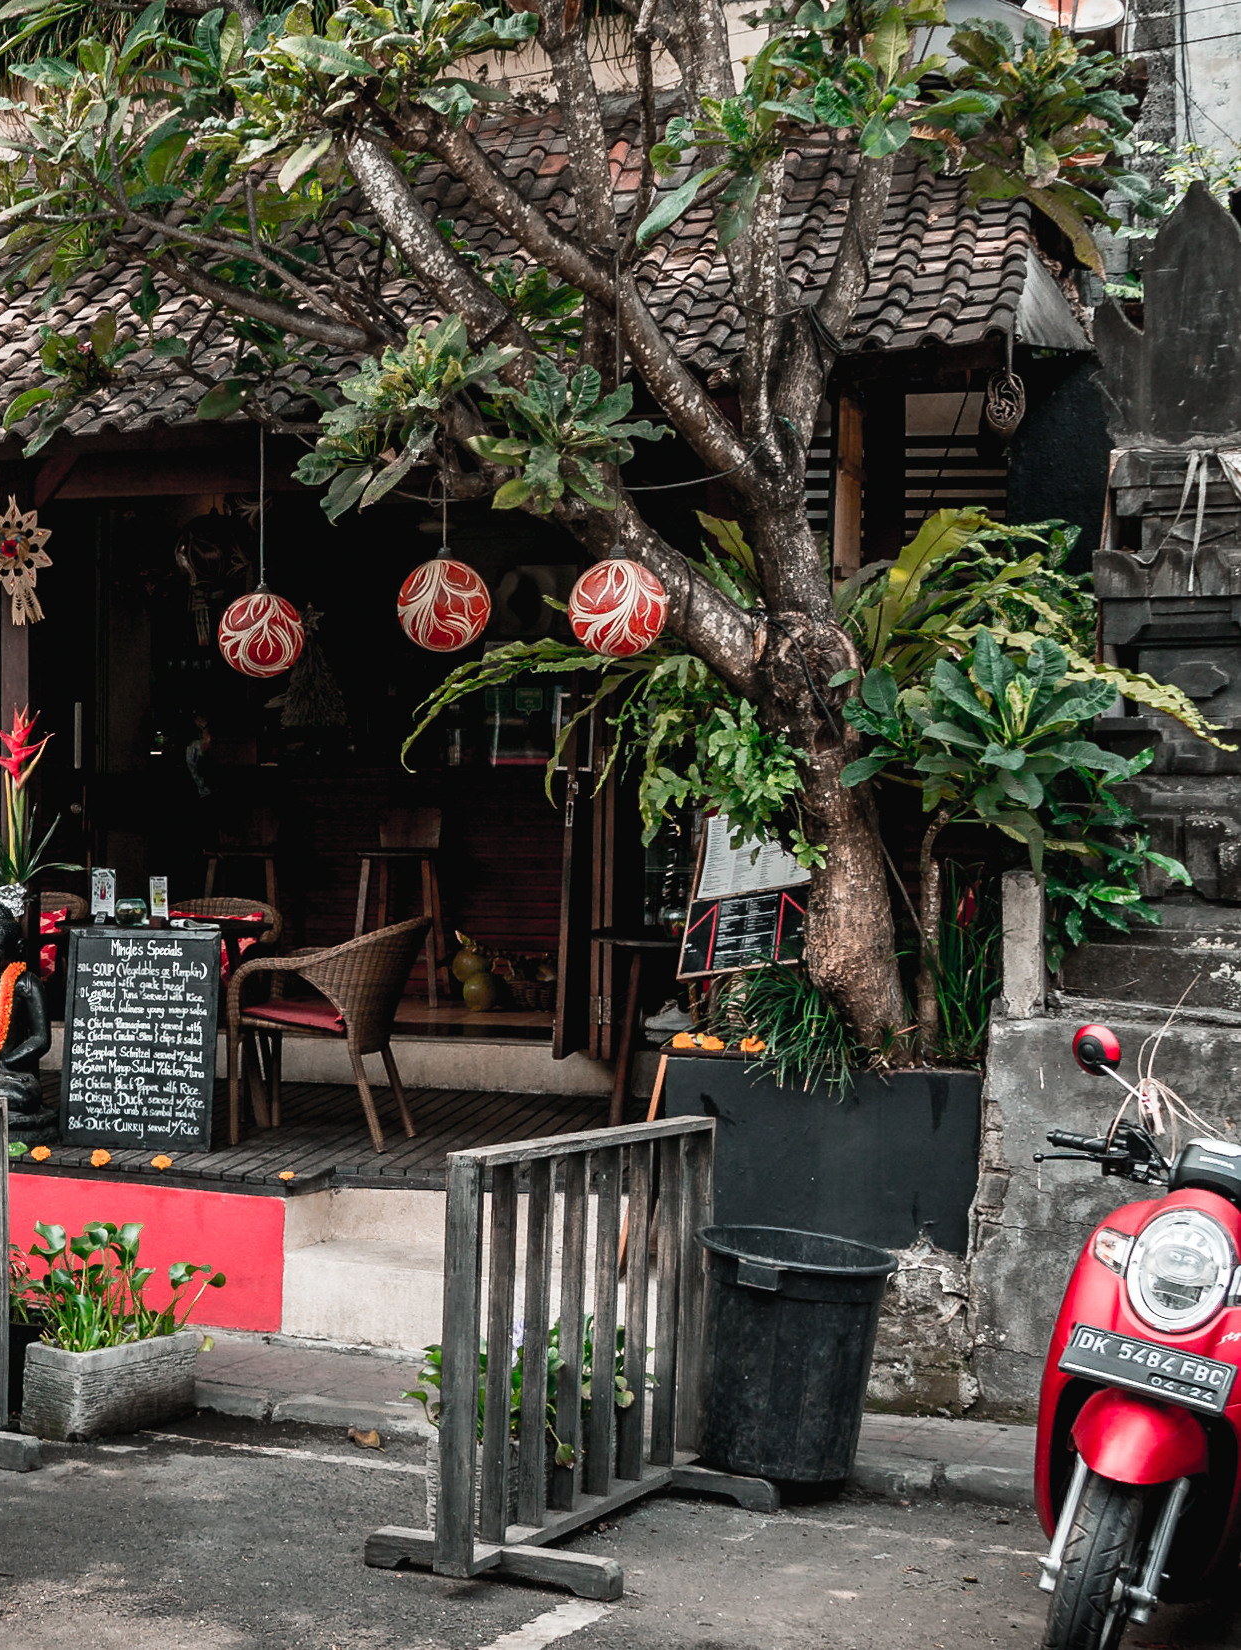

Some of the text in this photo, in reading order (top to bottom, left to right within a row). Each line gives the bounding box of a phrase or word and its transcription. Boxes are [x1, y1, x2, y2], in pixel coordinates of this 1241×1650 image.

[110, 939, 183, 962] Mingle's Specials
[92, 962, 115, 977] SOUP
[92, 977, 116, 987] served
[118, 976, 135, 988] with
[162, 977, 185, 992] bread
[142, 990, 168, 1001] served
[117, 1091, 143, 1106] Duck
[1078, 1332, 1225, 1386] DK 5484 FBC
